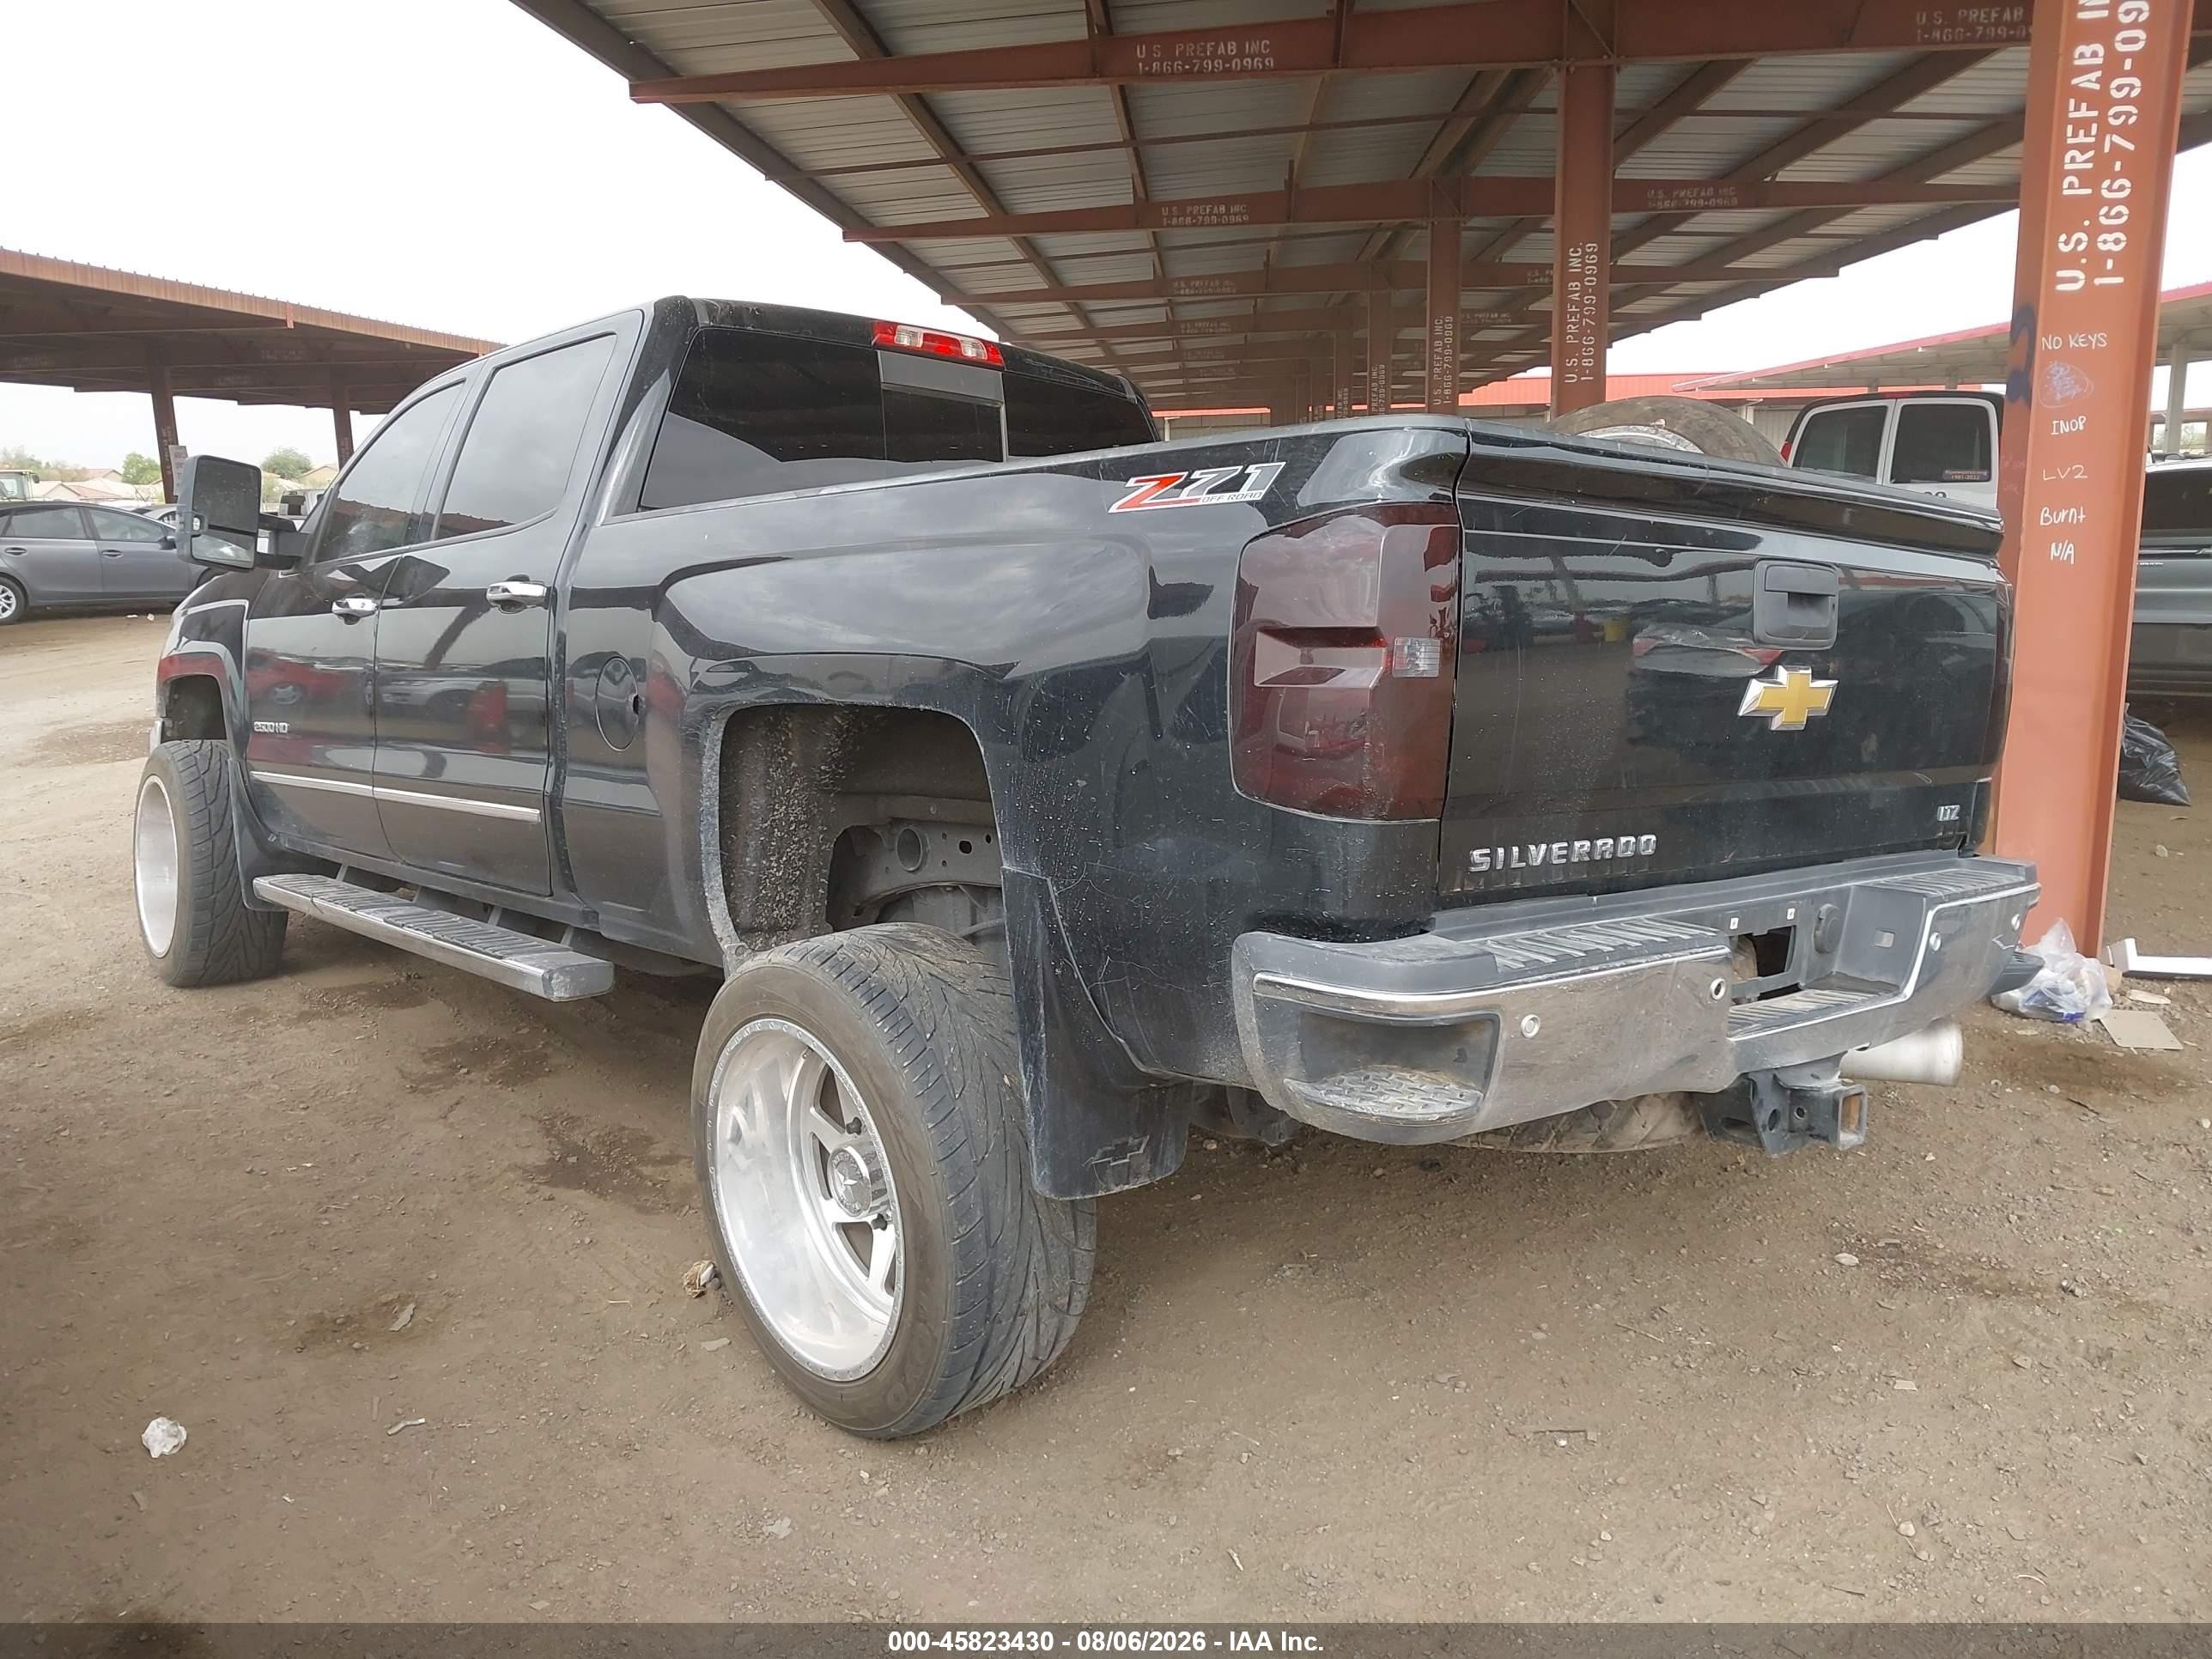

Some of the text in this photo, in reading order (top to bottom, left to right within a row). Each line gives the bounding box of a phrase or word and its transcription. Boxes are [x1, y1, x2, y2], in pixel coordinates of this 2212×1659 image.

[1958, 6, 2024, 23] PREFAB
[1176, 40, 1237, 58] PREFAB
[1138, 57, 1274, 76] 1-866-799-0969
[2063, 43, 2105, 195] PREFAB
[2056, 220, 2090, 291] U.S.
[1565, 242, 1583, 383] U.S. PREFAB INC.
[1581, 243, 1599, 380] 1-866-799-0969
[2041, 332, 2108, 351] NO KEYS
[1433, 340, 1443, 380] PREFAB
[1443, 316, 1454, 404] 1-866-799-0969
[1432, 386, 1443, 405] U.S.
[2051, 415, 2087, 435] INOP
[1108, 461, 1286, 514] Z71
[1202, 491, 1262, 503] OFF ROAD
[2039, 506, 2087, 526] Burnt
[2050, 538, 2075, 565] N/A
[1468, 834, 1656, 872] SILVERADO
